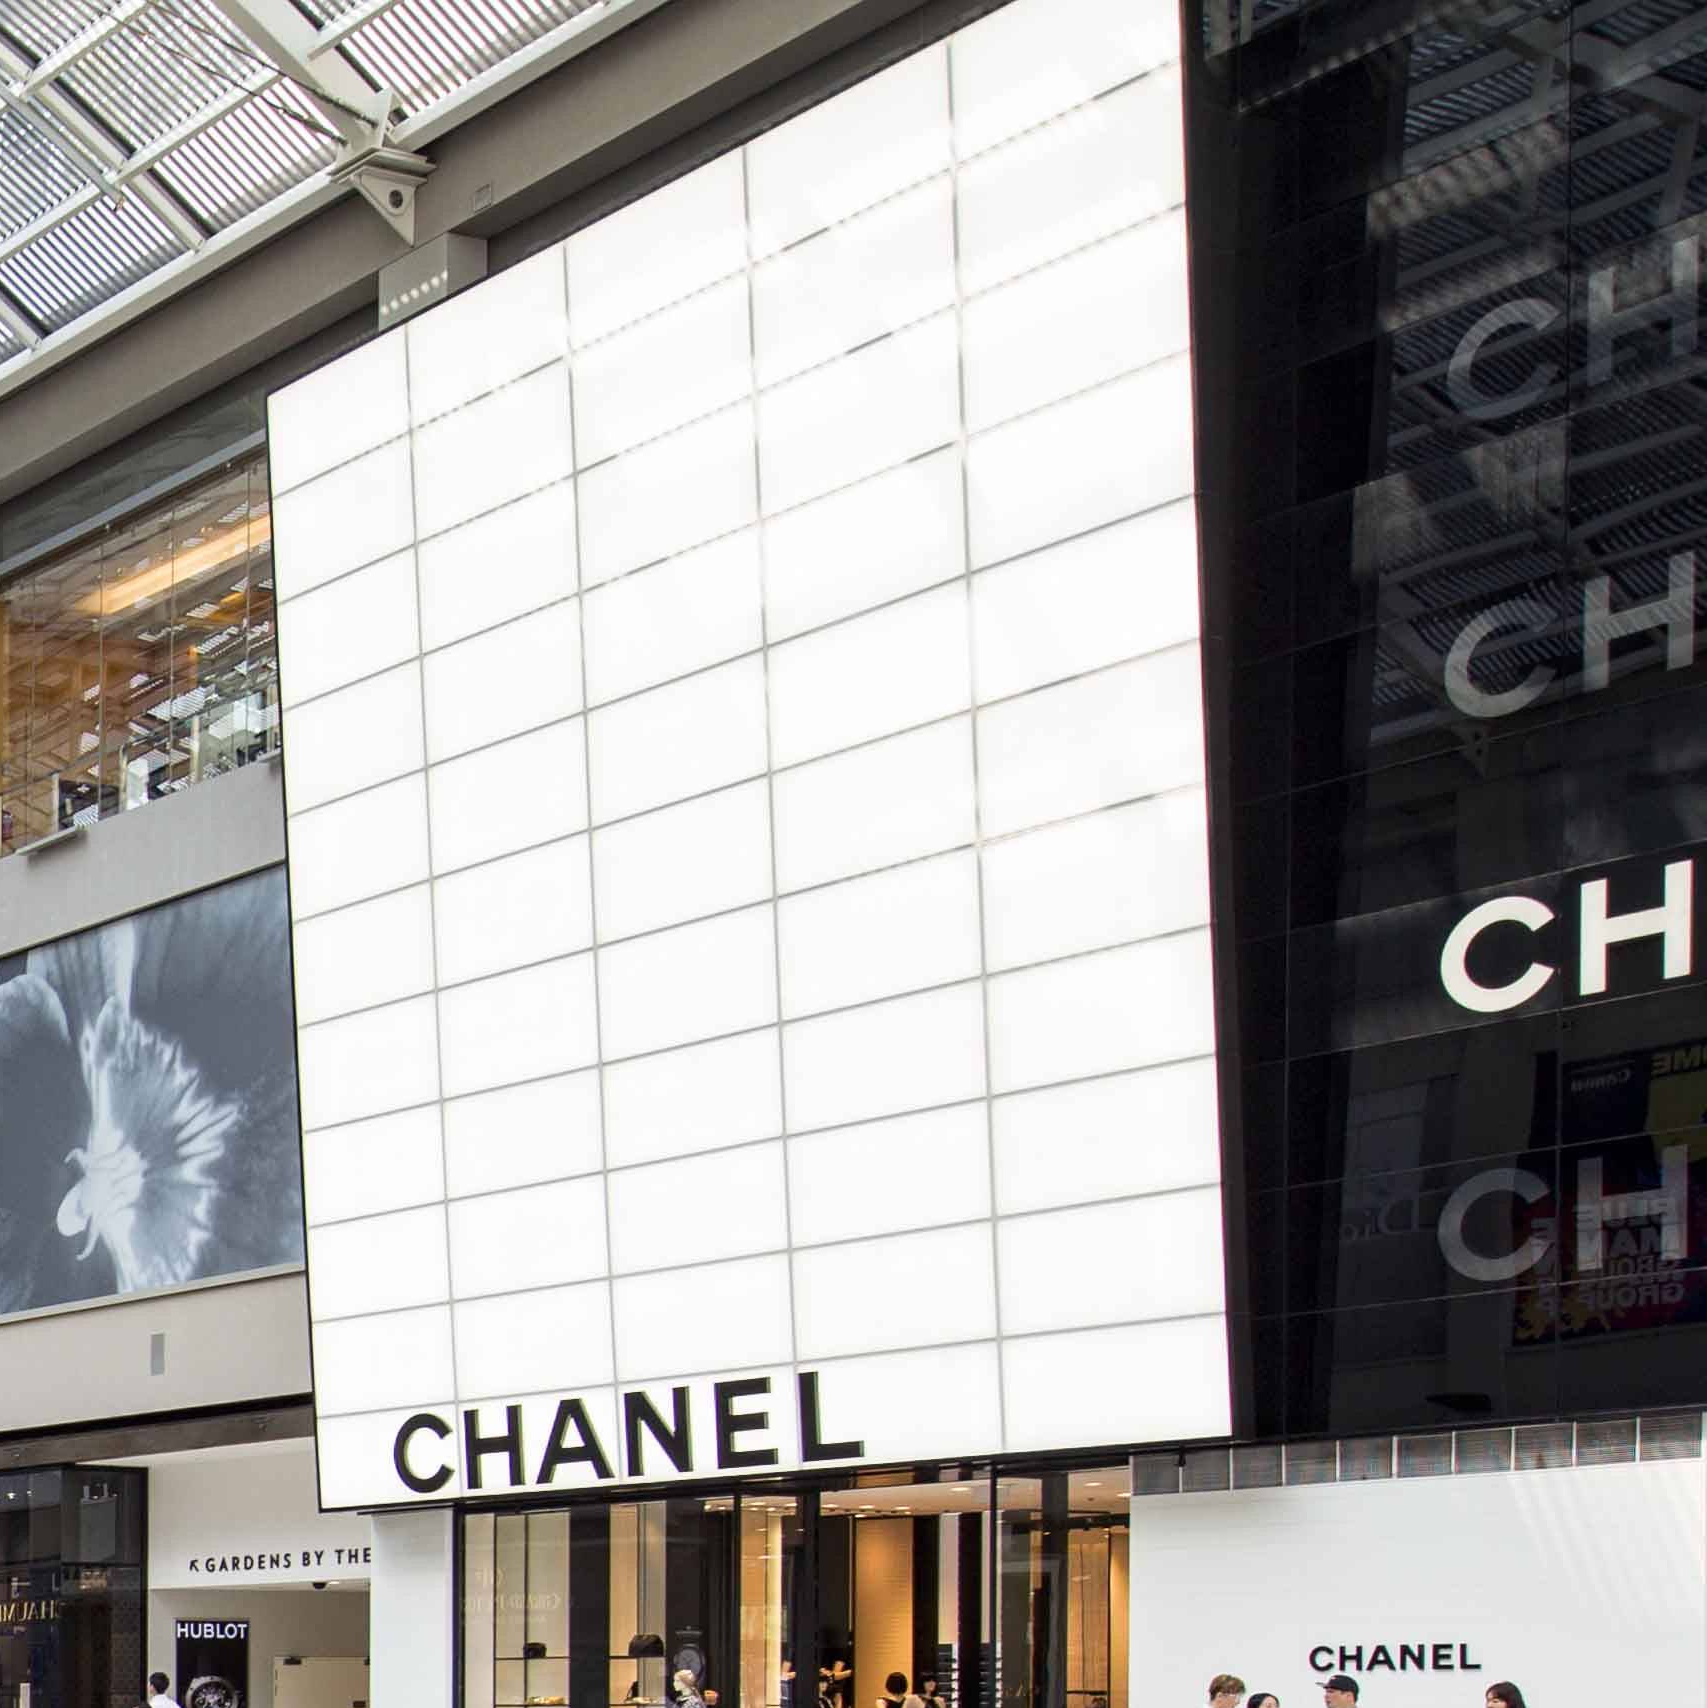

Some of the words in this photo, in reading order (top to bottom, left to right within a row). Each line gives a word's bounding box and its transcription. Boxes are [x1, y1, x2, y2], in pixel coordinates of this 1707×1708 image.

[393, 1370, 865, 1494] CHANEL
[205, 1553, 292, 1573] GARDENS
[302, 1550, 324, 1567] BY
[334, 1547, 371, 1565] THE
[176, 1623, 248, 1640] HUBLOT
[1309, 1643, 1482, 1672] CHANEL
